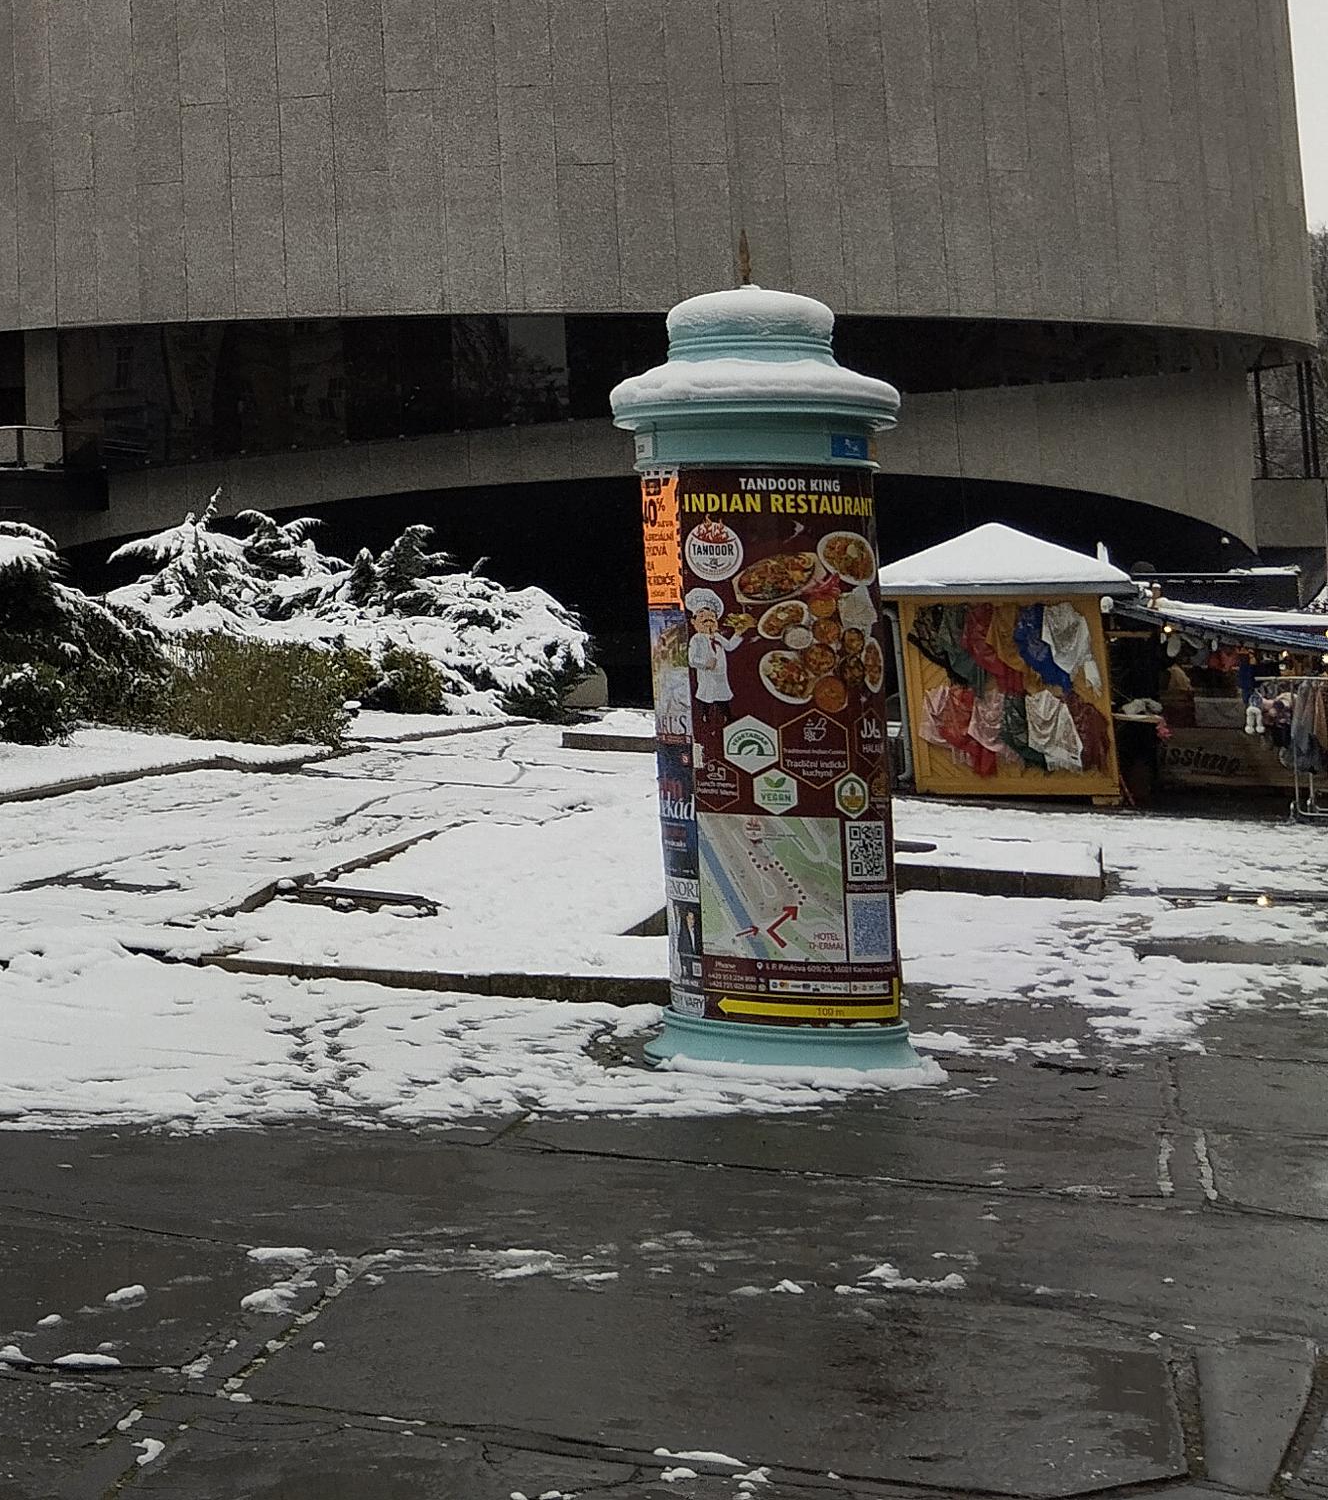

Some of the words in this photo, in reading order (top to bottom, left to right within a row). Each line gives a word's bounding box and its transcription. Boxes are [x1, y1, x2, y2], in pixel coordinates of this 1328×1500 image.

[739, 477, 806, 492] TANDOOR
[810, 479, 841, 492] KING
[684, 493, 762, 513] INDIAN
[770, 494, 873, 517] RESTAURANT
[691, 543, 735, 556] TANDOOR
[760, 792, 792, 803] VEGAN
[813, 932, 840, 941] HOTEL
[808, 941, 846, 950] THERMAL
